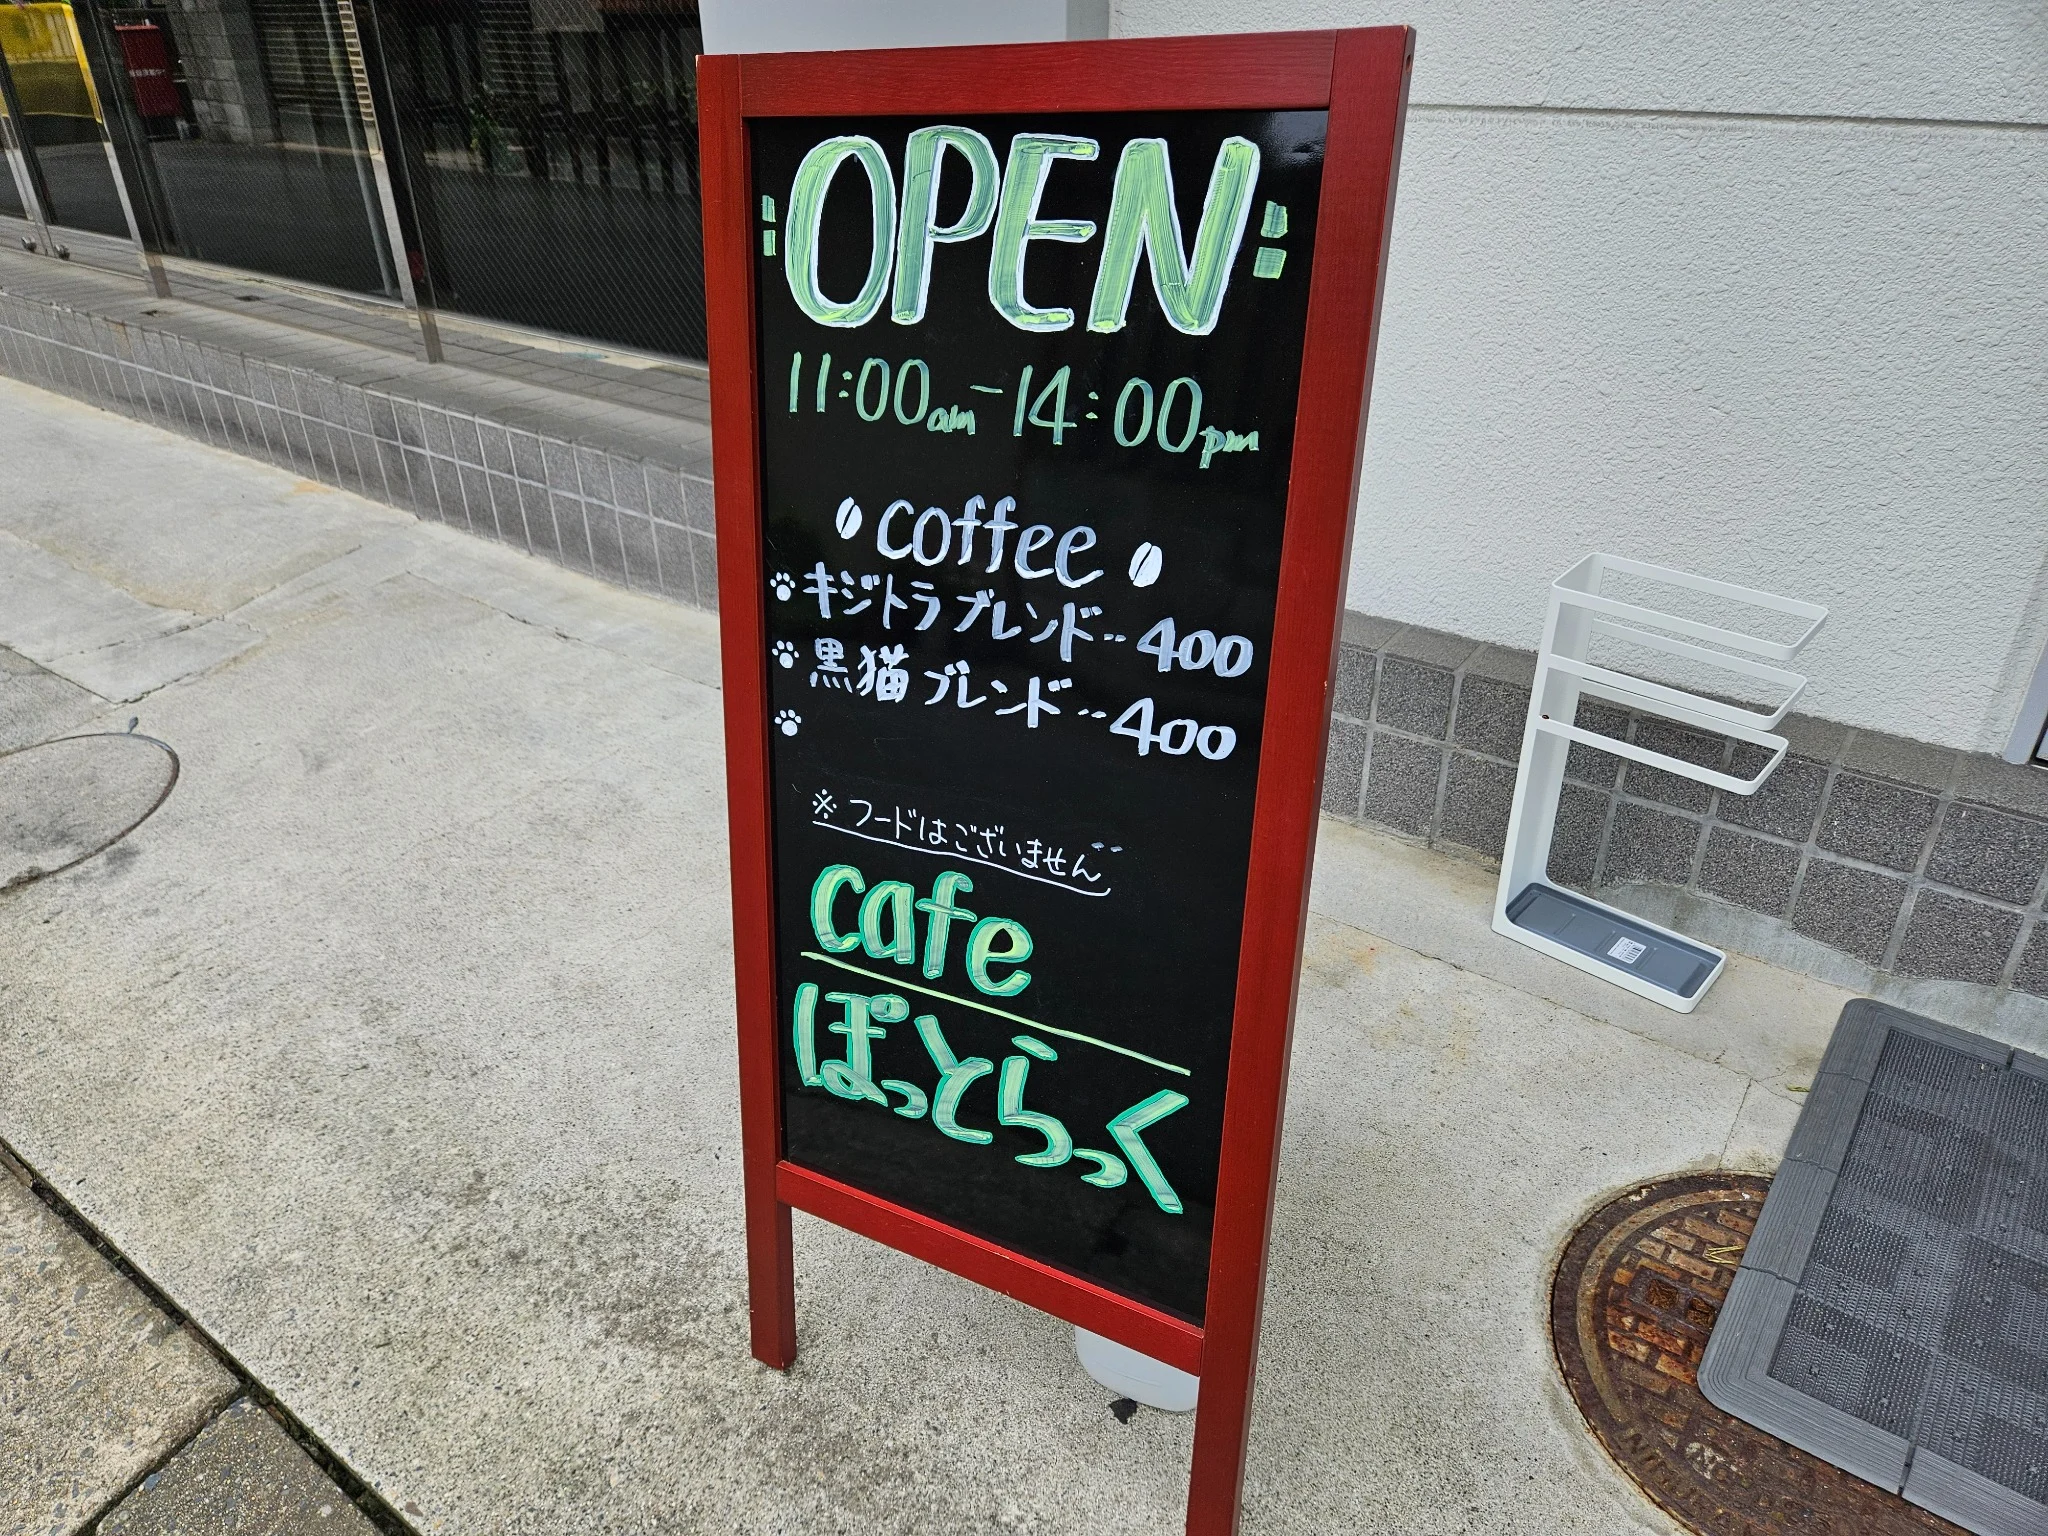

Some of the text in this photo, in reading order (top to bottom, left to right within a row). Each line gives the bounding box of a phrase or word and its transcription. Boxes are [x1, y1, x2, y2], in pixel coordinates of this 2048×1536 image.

[785, 125, 1261, 335] OPEN
[876, 494, 1104, 588] coffee
[1136, 616, 1254, 678] 400
[1109, 697, 1237, 761] 400
[810, 863, 1034, 997] cafe
[792, 982, 1190, 1215] ぽっとらっく
